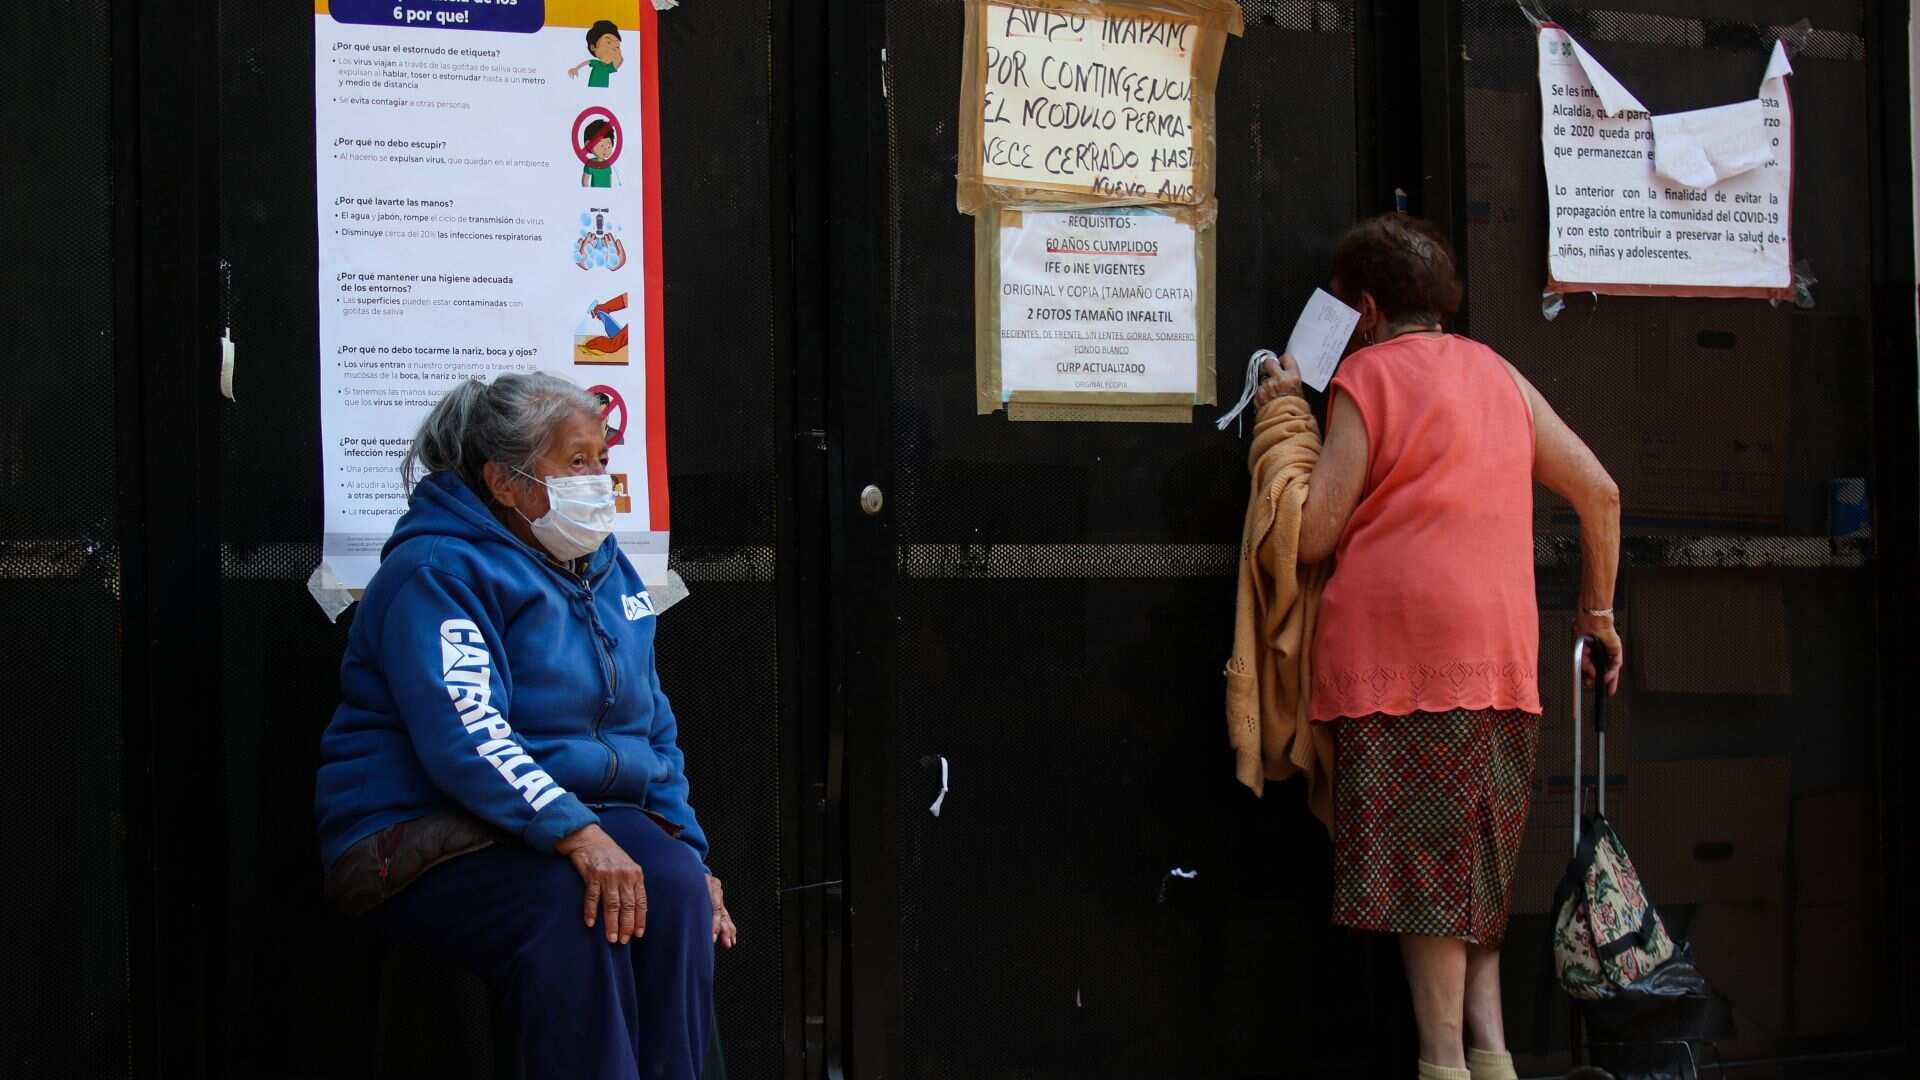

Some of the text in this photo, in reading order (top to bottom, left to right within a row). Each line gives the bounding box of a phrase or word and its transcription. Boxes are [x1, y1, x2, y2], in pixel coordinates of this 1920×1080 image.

[393, 7, 469, 25] 6 por que!
[332, 42, 352, 51] ¿Por
[354, 44, 370, 52] qué
[460, 48, 501, 57] etiqueta?
[374, 58, 397, 68] viajan
[987, 47, 1030, 88] POR
[382, 70, 409, 78] hablar,
[439, 73, 481, 81] estornudar
[384, 80, 418, 88] distancia
[1552, 84, 1563, 96] Se
[1566, 85, 1579, 97] les
[350, 96, 408, 107] evita contagiar
[984, 91, 1010, 123] EL
[1023, 97, 1116, 130] MODULO
[1553, 104, 1594, 119] Alcaldía,
[1554, 124, 1629, 140] de 2020 queda
[334, 138, 353, 146] ¿Por
[387, 139, 409, 147] debo
[411, 141, 447, 150] escupir?
[389, 155, 424, 163] expulsan
[1045, 142, 1139, 174] CERRADO
[1554, 146, 1642, 159] que permanezcan
[1555, 184, 1778, 205] Lo anterior con la finalidad de evitar la
[334, 197, 355, 205] ¿Por
[375, 197, 405, 206] lavarte
[1557, 205, 1778, 224] propagación entre la comunidad del COVID-19
[1069, 216, 1130, 229] REQUISITOS
[341, 228, 383, 238] Disminuye
[495, 233, 543, 241] respiratorias
[1557, 227, 1779, 243] y con esto contribuir a preservar la salud de
[1047, 237, 1158, 252] 60 AÑOS CUMPLIDOS
[1559, 244, 1691, 260] niños, niñas y adolescentes.
[1045, 262, 1145, 276] IFE o INE VIGENTES
[336, 272, 356, 281] ¿Por
[358, 273, 375, 281] qué
[439, 274, 471, 284] higiene
[472, 275, 513, 283] adecuada
[340, 283, 352, 291] de
[354, 284, 366, 292] los
[1004, 284, 1193, 301] ORIGINAL Y COPIA (TAMAÑO CARTA)
[357, 296, 508, 307] superficies contaminadas
[1028, 308, 1173, 322] 2 FOTOS TAMAÑO INFALTIL
[337, 345, 357, 354] ¿Por
[461, 347, 484, 355] nariz,
[486, 347, 507, 355] boca
[515, 348, 537, 357] ojos?
[1057, 362, 1145, 374] CURP ACTUALIZADO
[422, 372, 429, 380] la
[430, 372, 450, 380] nariz
[471, 375, 486, 384] ojos
[339, 437, 377, 447] ¿Por qué
[344, 448, 383, 456] infección
